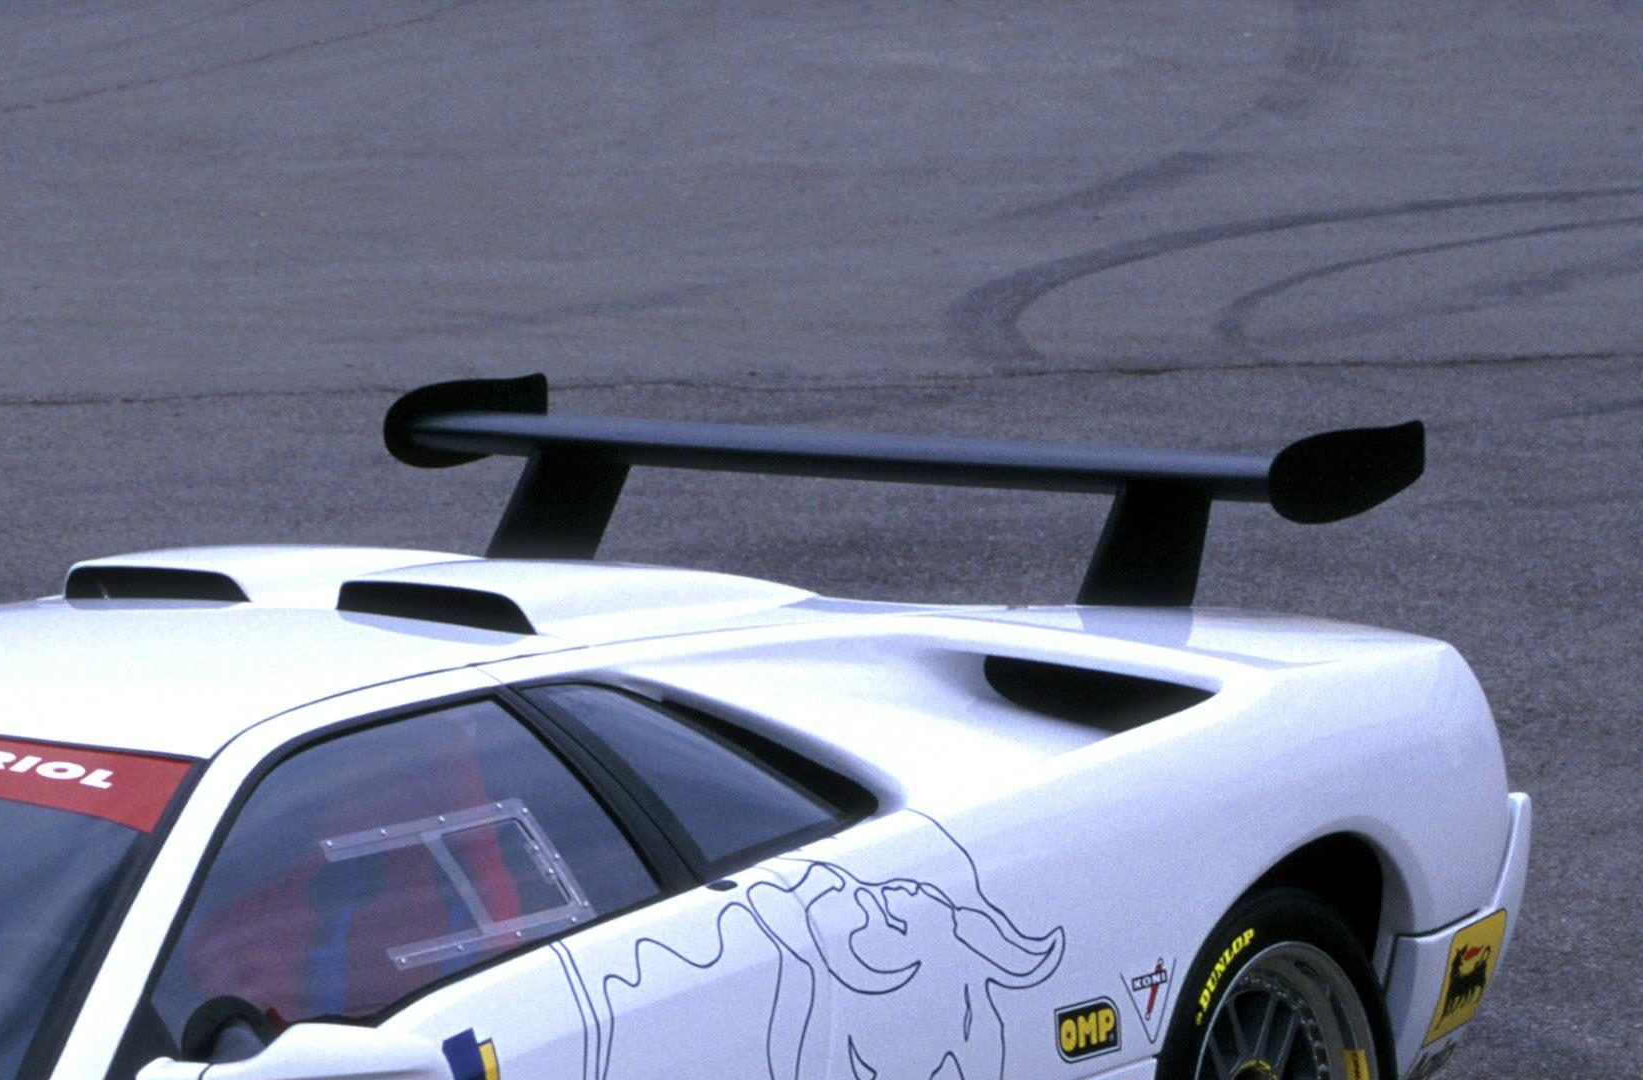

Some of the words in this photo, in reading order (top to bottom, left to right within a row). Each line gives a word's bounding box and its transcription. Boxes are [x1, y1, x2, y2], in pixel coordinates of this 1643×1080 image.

[1133, 970, 1167, 990] KONI
[1199, 928, 1255, 1008] DUNLOP
[1060, 1008, 1116, 1053] OMP
